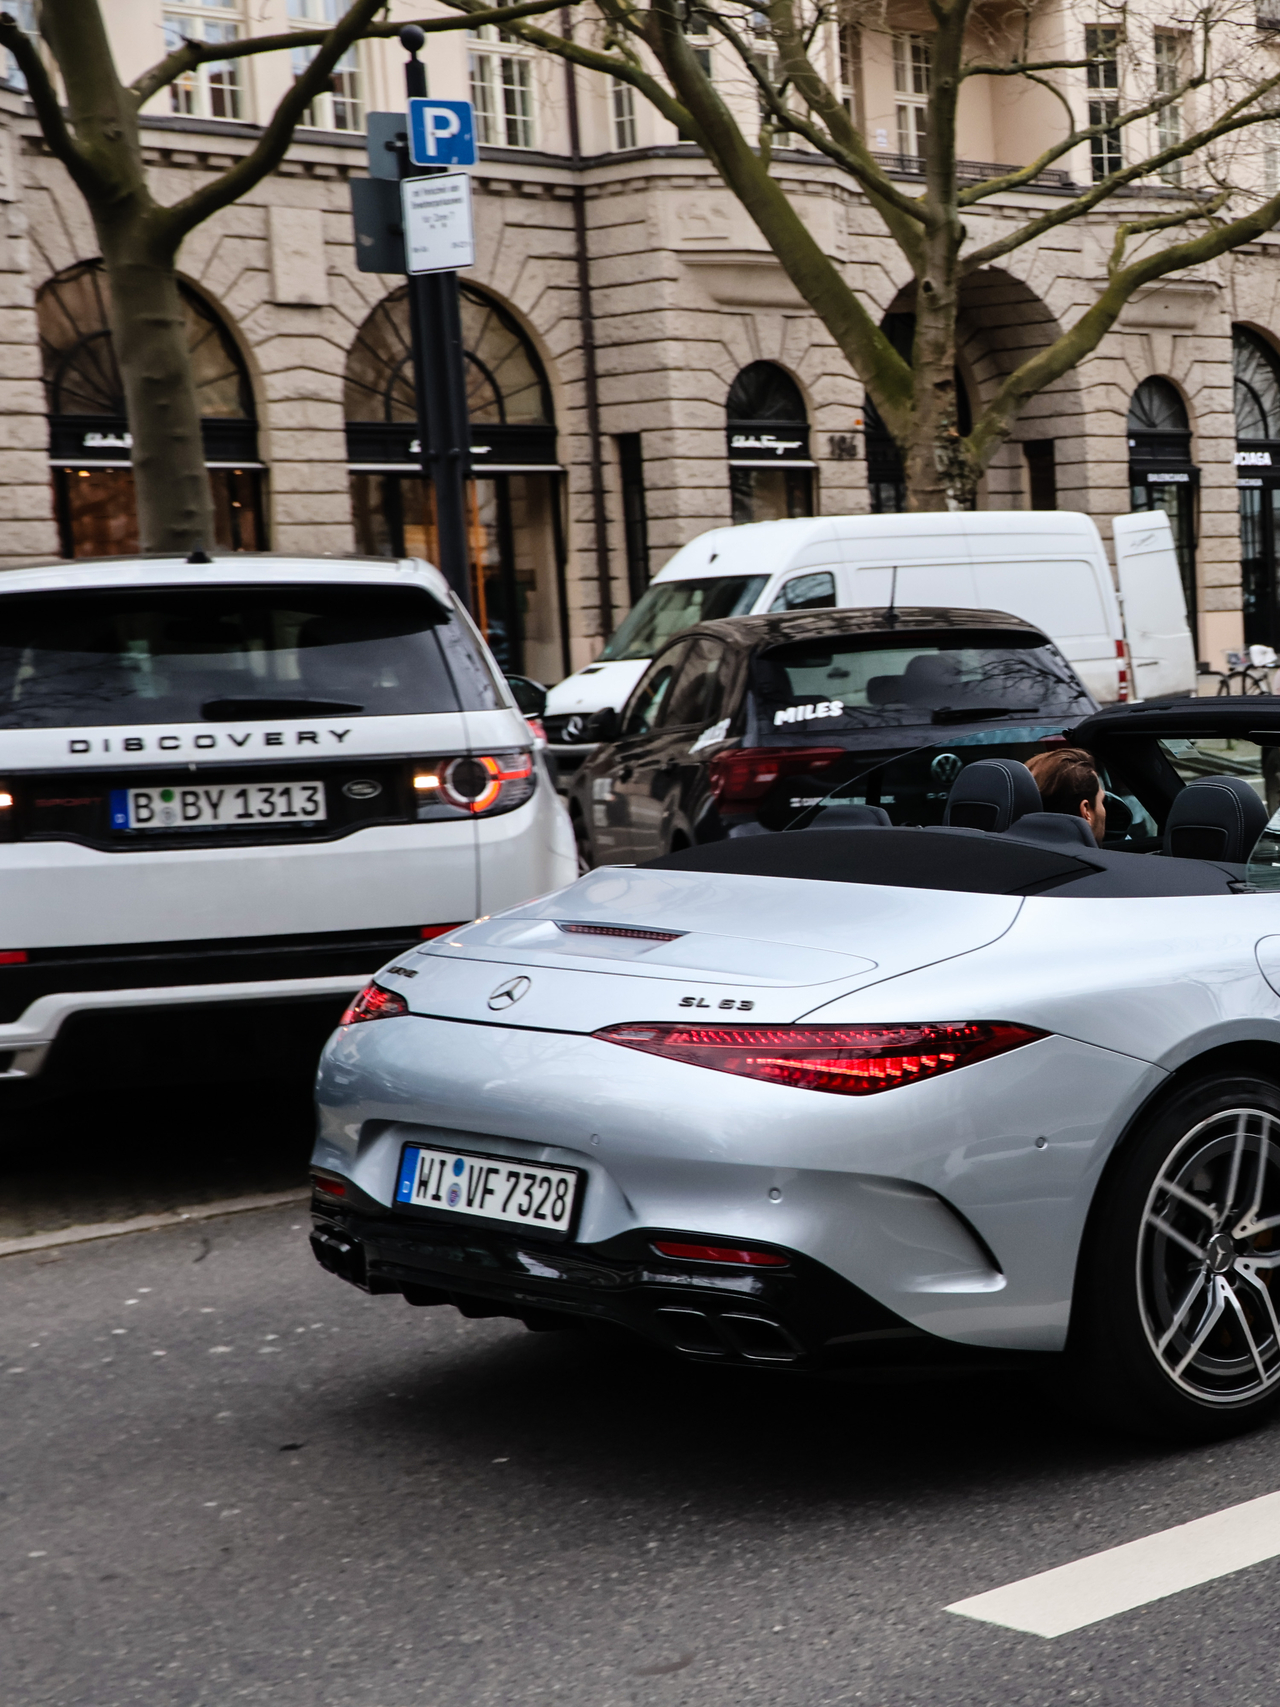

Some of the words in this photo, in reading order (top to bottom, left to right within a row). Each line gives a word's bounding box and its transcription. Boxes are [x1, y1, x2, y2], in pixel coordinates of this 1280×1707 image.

[423, 106, 461, 156] P
[773, 700, 844, 726] MILES
[69, 729, 352, 753] DISCOVERY
[134, 792, 155, 823] B
[182, 789, 225, 820] BY
[235, 786, 320, 819] 1313
[679, 996, 711, 1009] SL
[718, 998, 755, 1012] 63
[416, 1156, 447, 1202] WI
[466, 1164, 500, 1209] VF
[502, 1170, 568, 1223] 7328
